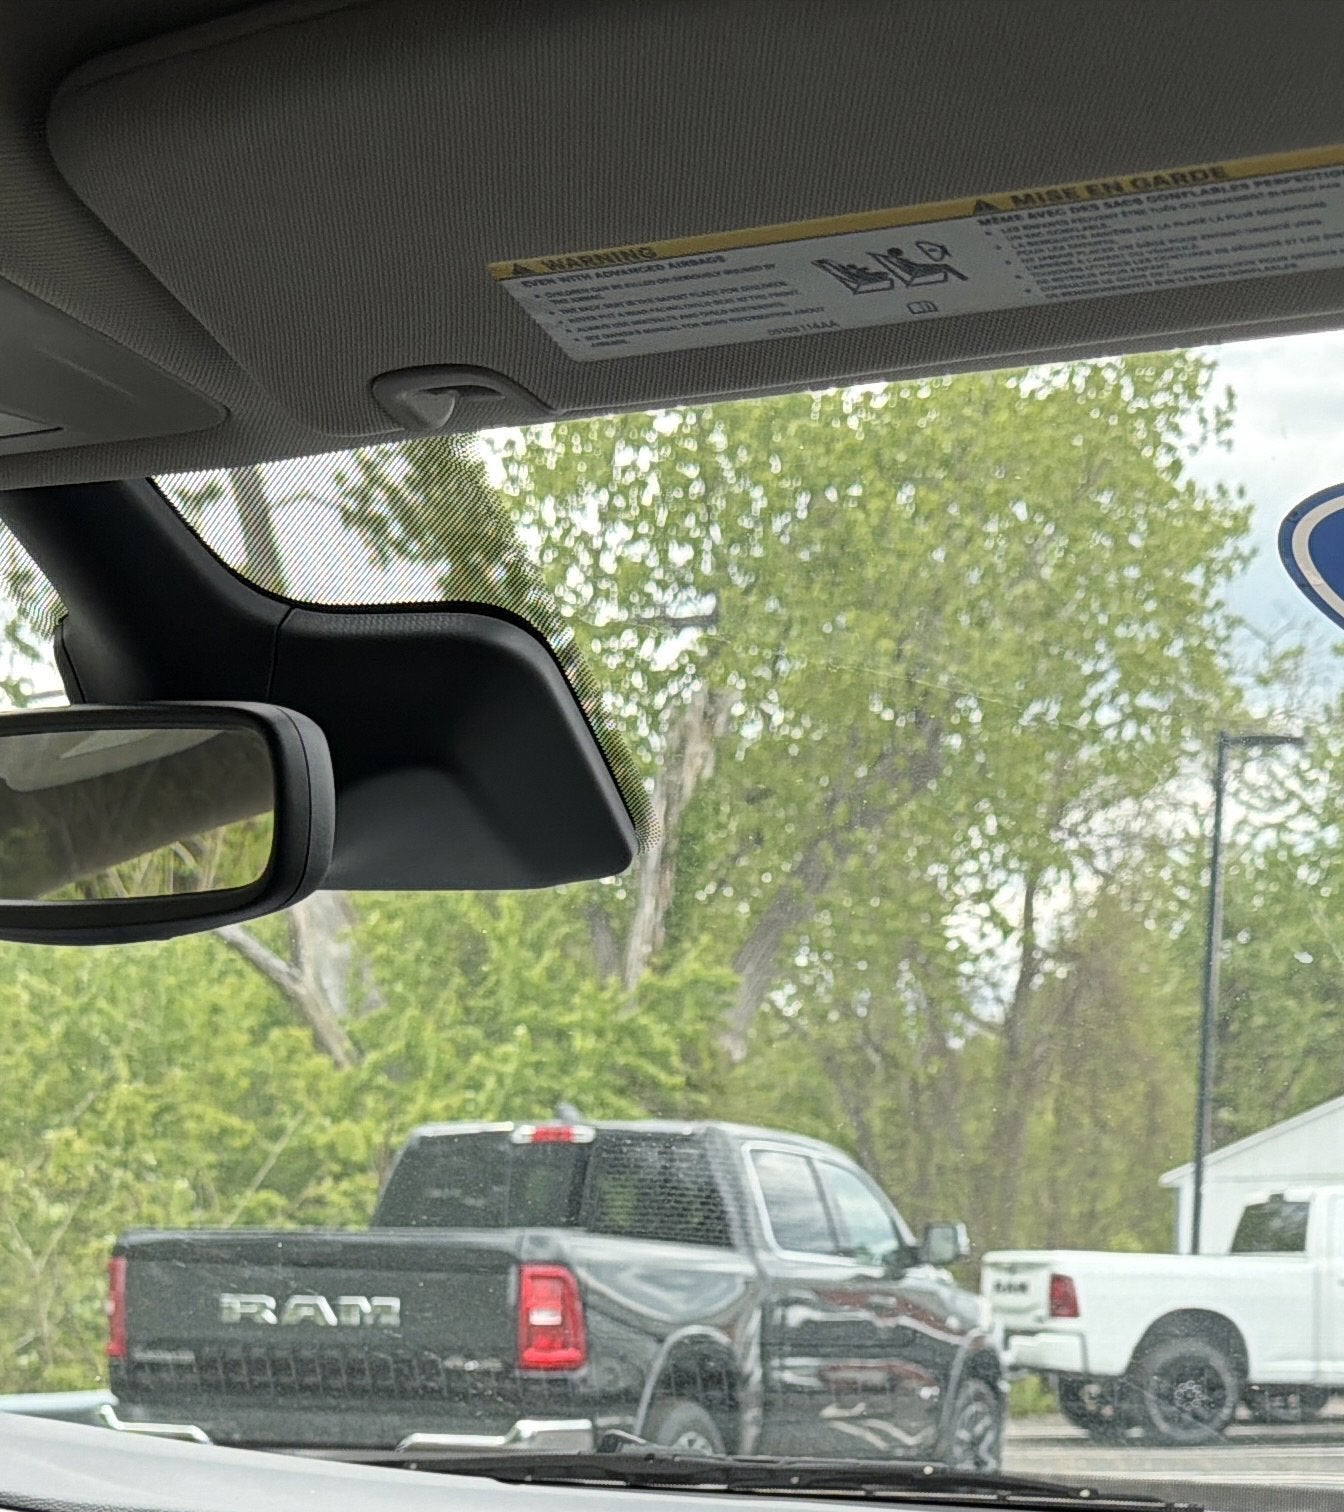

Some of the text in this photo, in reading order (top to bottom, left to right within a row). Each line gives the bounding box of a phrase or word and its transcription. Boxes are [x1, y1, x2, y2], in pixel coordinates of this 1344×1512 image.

[1010, 165, 1228, 208] MISE EN GARDE
[541, 246, 656, 271] WARNING
[219, 1292, 401, 1326] RAM
